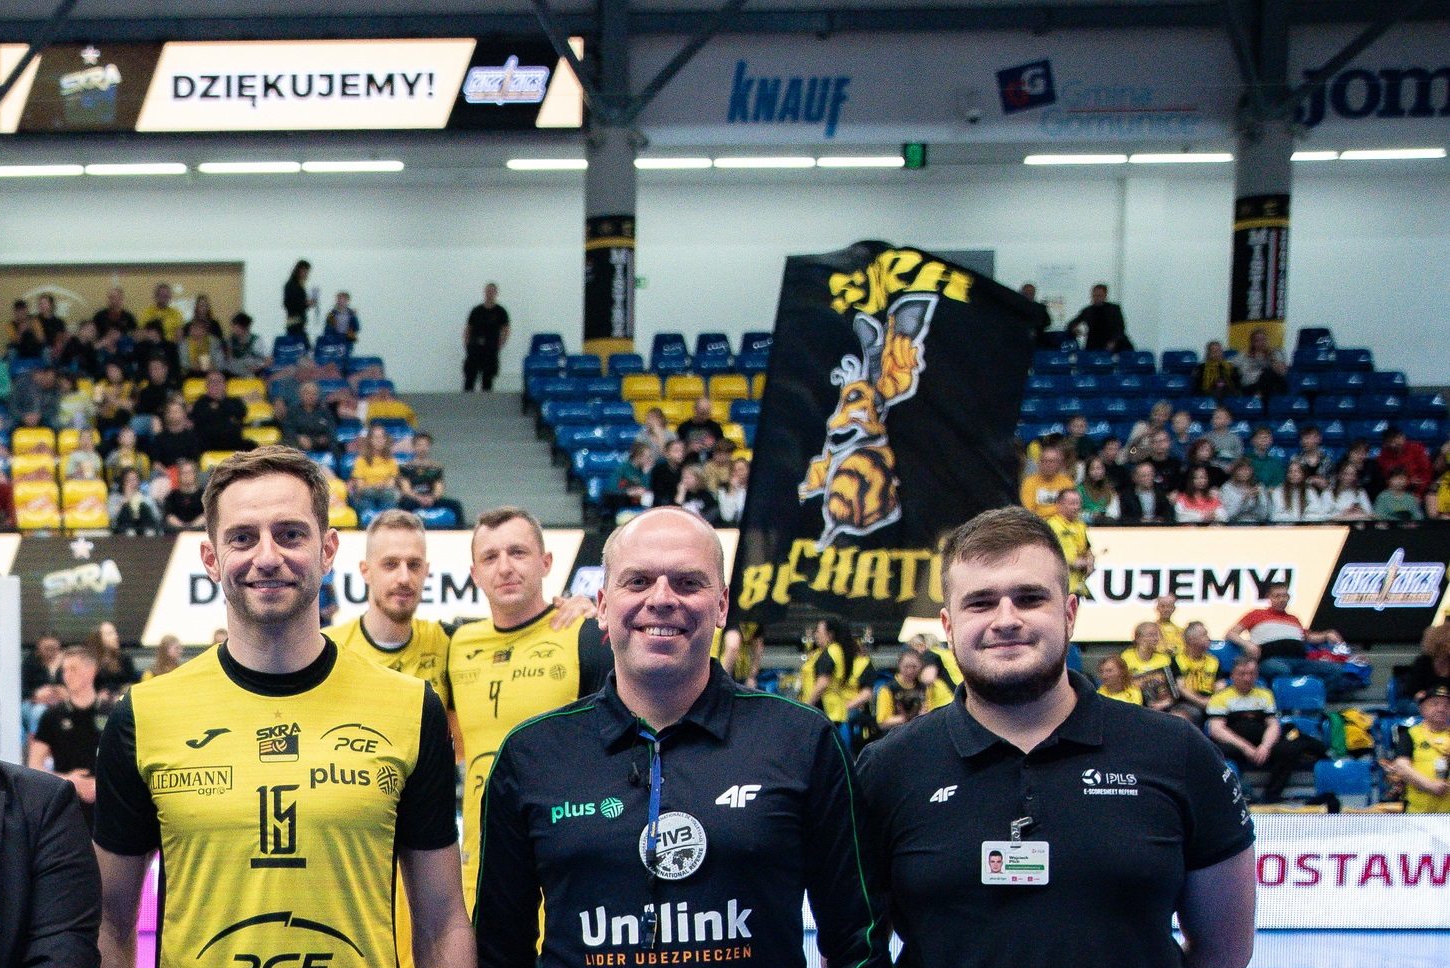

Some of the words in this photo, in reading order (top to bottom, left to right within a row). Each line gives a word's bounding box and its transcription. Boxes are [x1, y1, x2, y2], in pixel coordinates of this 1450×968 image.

[172, 72, 434, 108] DZIĘKUJEMY!
[727, 60, 851, 138] KNAUF
[511, 667, 545, 681] plus
[255, 722, 302, 742] SKRA
[334, 737, 379, 754] PGE
[310, 763, 371, 789] plus
[715, 785, 762, 808] 4F
[930, 785, 958, 803] 4F
[255, 784, 301, 855] 15
[551, 800, 596, 824] plus
[1256, 853, 1450, 888] OSTAW
[579, 898, 753, 947] Unlink
[585, 952, 627, 967] LIDER
[635, 942, 752, 965] UBEZPIECZEŃ
